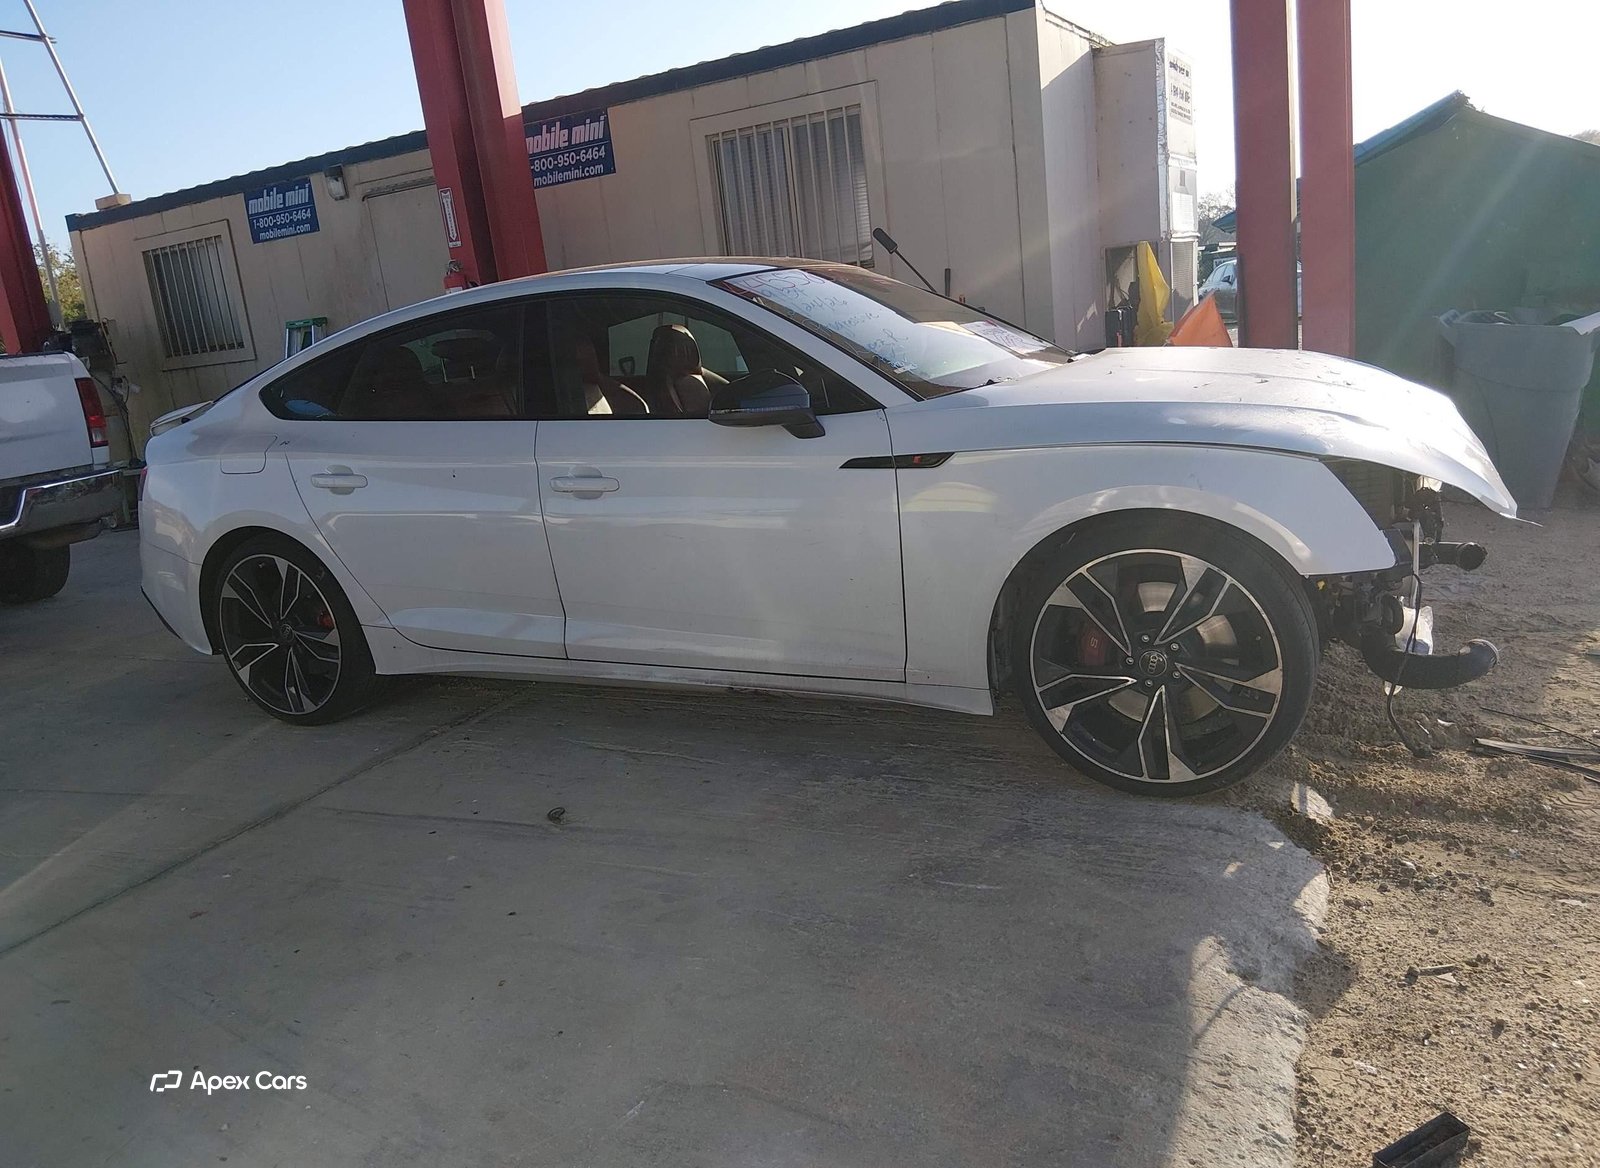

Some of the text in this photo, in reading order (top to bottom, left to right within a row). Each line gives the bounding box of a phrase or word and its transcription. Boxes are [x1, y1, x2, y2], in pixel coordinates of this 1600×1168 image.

[571, 115, 605, 145] mini
[530, 145, 606, 172] -800-950-6464
[533, 163, 604, 187] mobilemini.com
[248, 183, 309, 215] mobile mini
[253, 208, 312, 230] 1-800-950-6464
[259, 223, 311, 240] mobilemini.com
